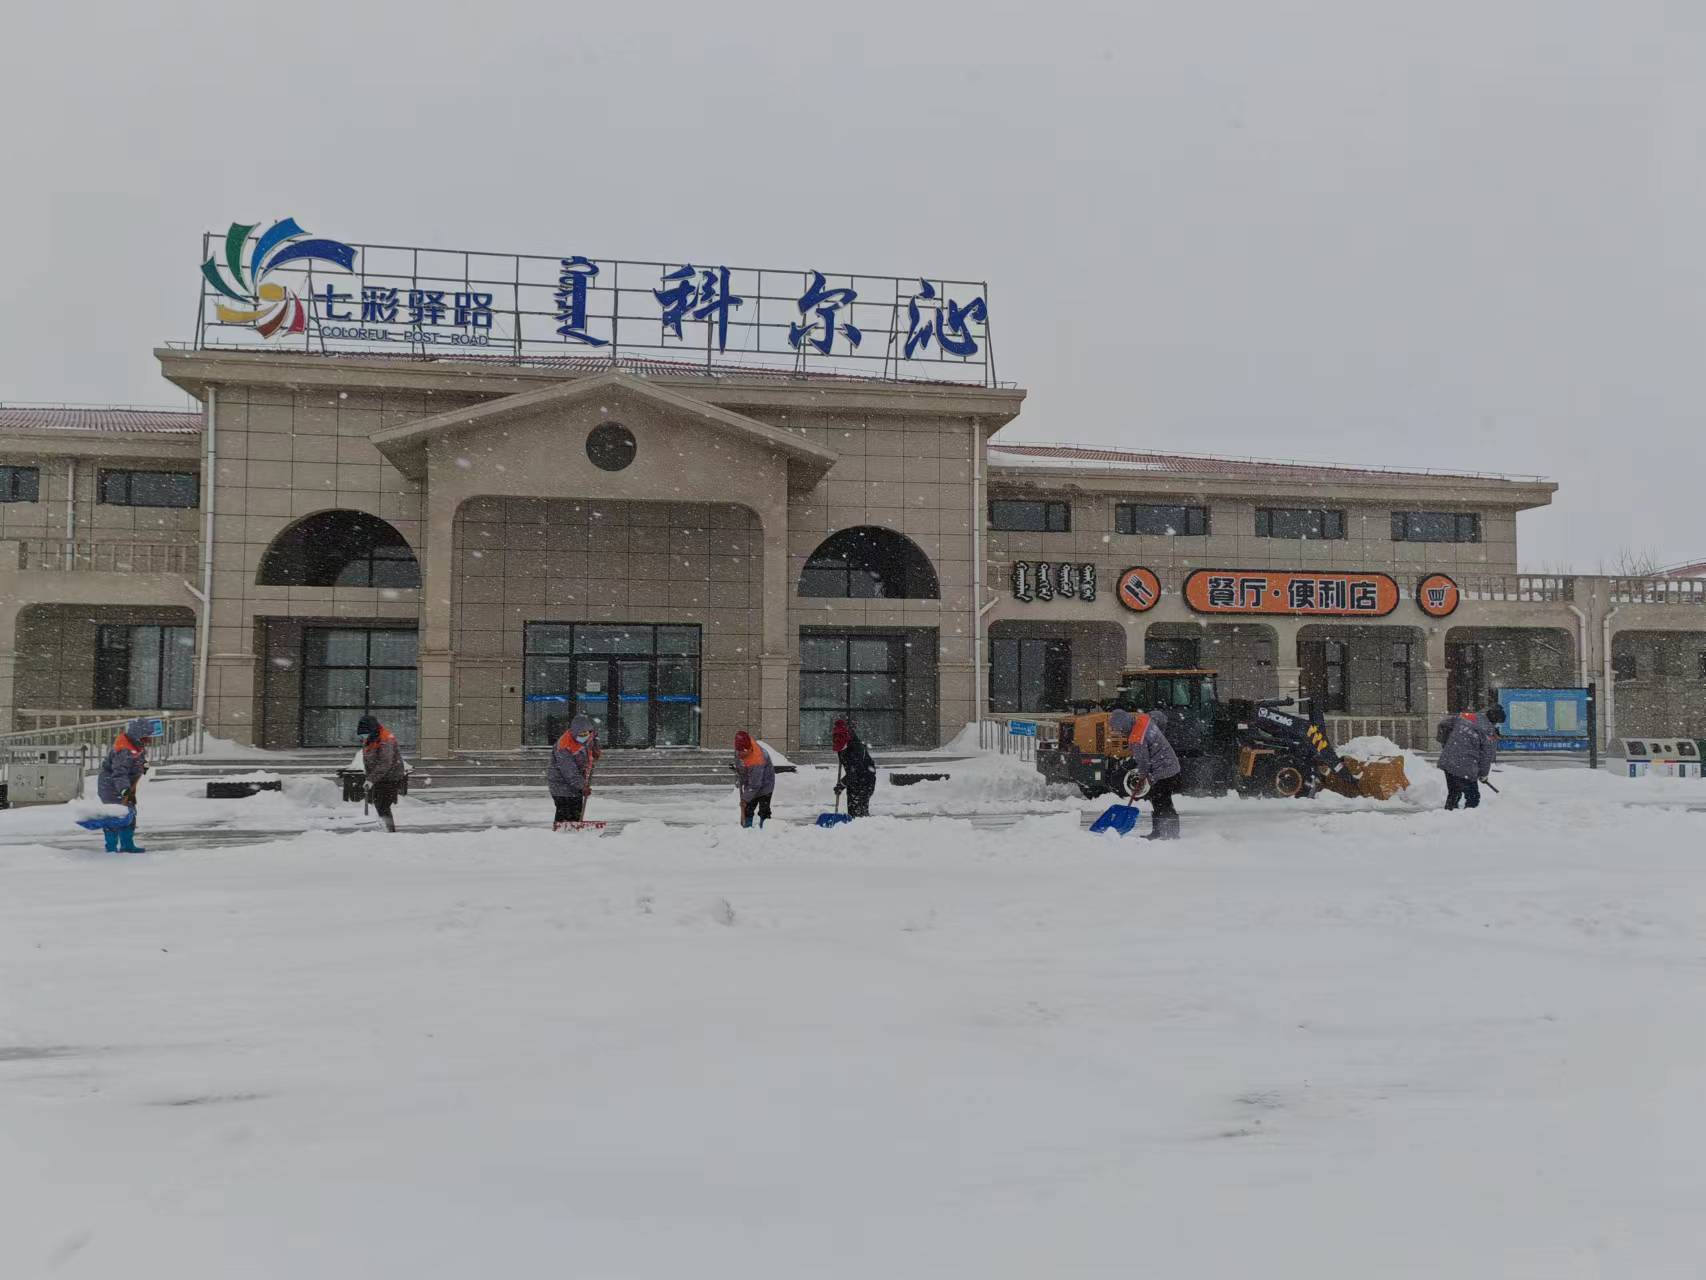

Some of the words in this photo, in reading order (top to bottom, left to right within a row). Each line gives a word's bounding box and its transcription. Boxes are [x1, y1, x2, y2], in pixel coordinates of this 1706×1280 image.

[313, 284, 493, 329] 七彩驿路
[652, 263, 989, 360] 科尔沁
[321, 326, 391, 341] COLORFUL
[403, 331, 440, 344] POST
[451, 333, 489, 346] ROAD
[1207, 577, 1378, 611] 餐厅·便利店
